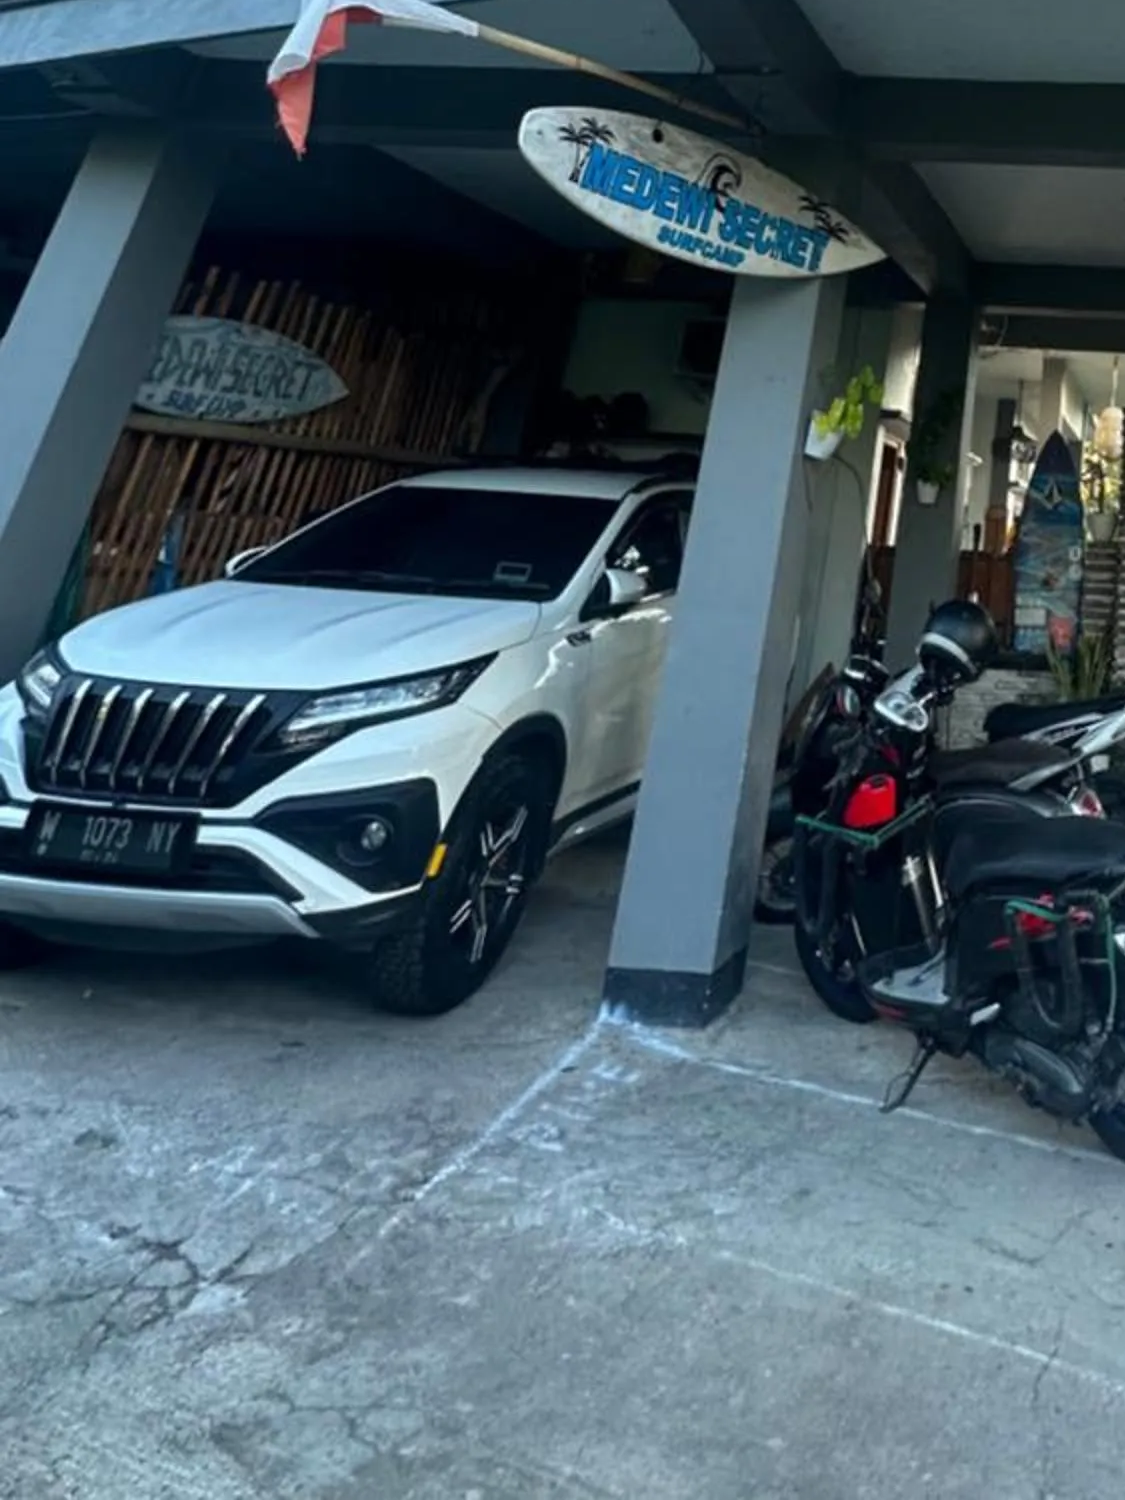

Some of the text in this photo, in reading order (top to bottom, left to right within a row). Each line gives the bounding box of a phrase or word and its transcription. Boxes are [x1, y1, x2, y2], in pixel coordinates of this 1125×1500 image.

[578, 140, 831, 272] MEDEWI SECRET
[656, 224, 746, 268] SURFCAMP
[220, 345, 320, 401] SECRET
[82, 815, 134, 849] 1073
[146, 820, 182, 853] NY
